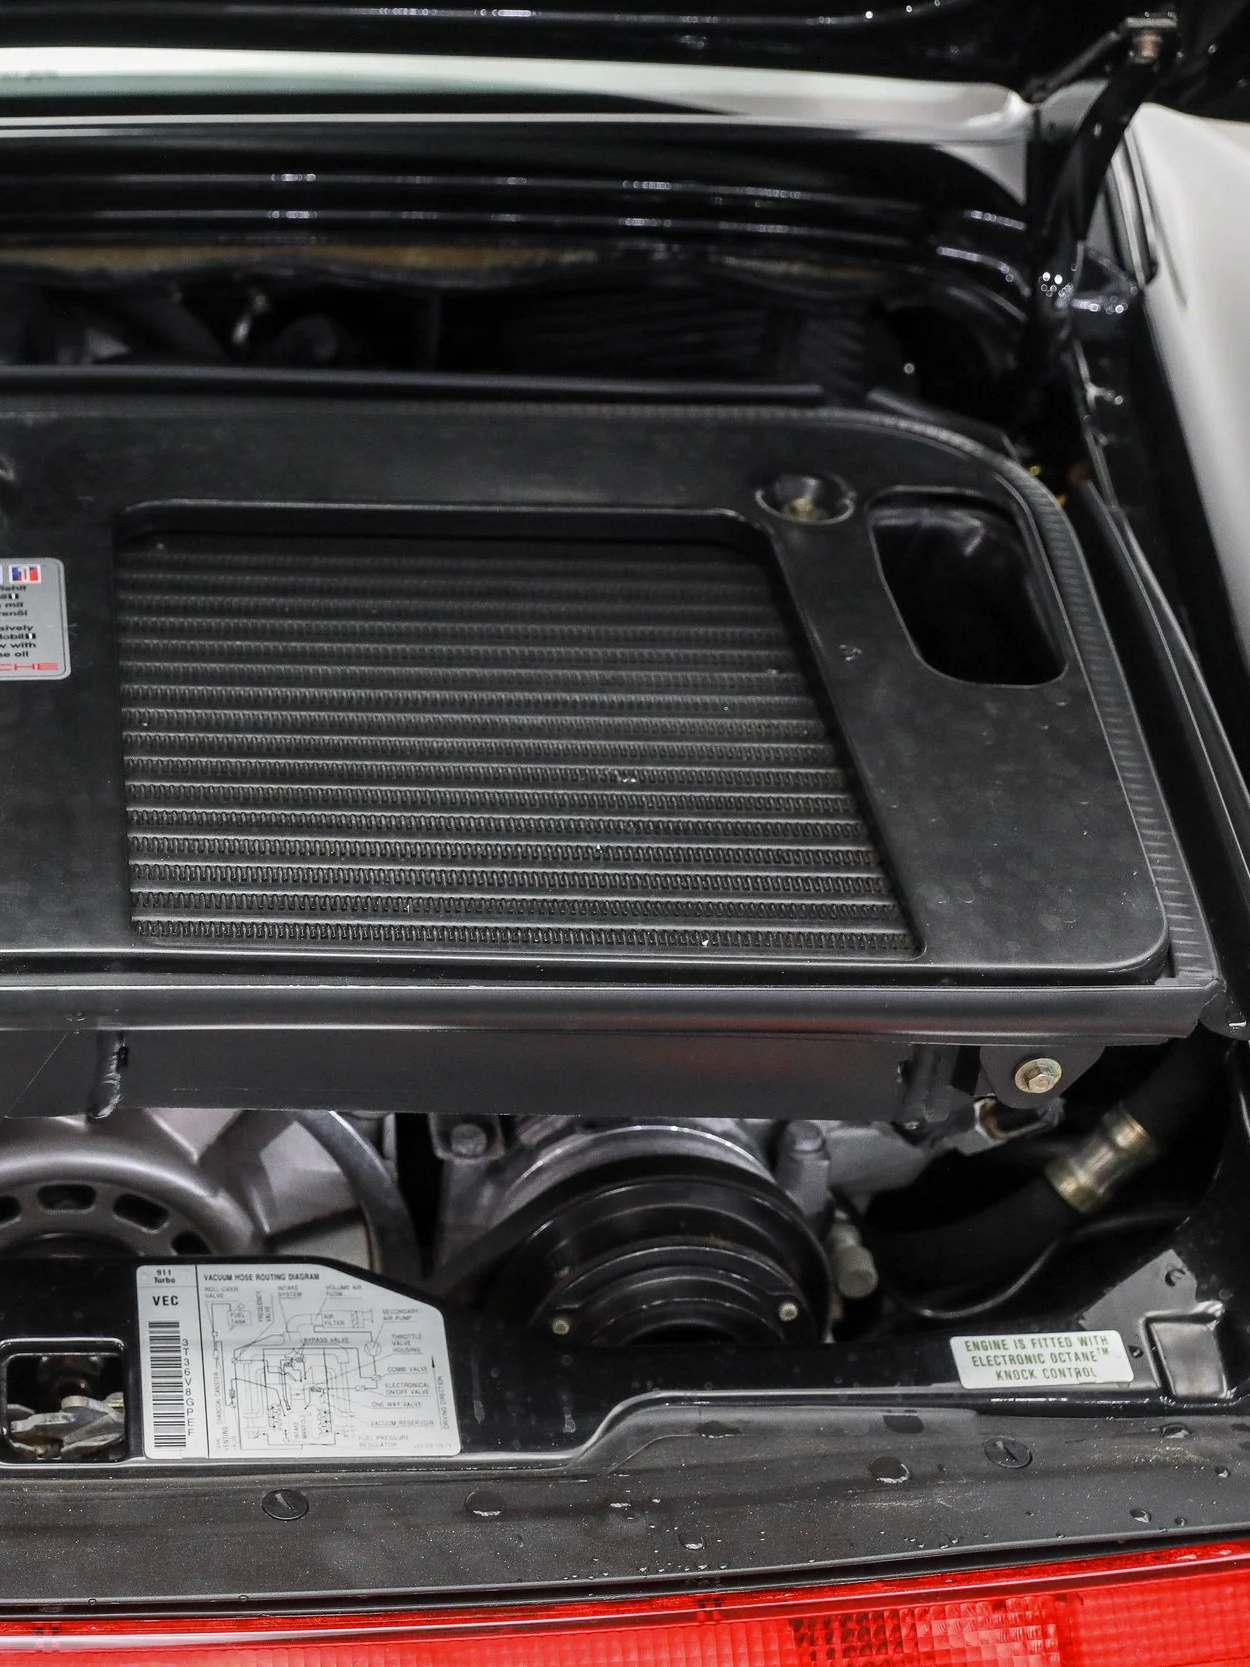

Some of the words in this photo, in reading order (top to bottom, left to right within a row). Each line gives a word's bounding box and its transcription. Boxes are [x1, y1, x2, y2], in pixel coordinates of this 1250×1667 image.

[255, 1273, 286, 1281] ROUTING
[153, 1296, 179, 1306] VEC
[965, 1341, 1009, 1352] ENGINE
[1014, 1339, 1026, 1350] IS
[1031, 1337, 1072, 1349] FITTED
[1079, 1336, 1108, 1347] WITH
[972, 1354, 1045, 1367] ELECTRONIC
[995, 1368, 1036, 1381] KNOCK
[1042, 1367, 1097, 1379] CONTROL
